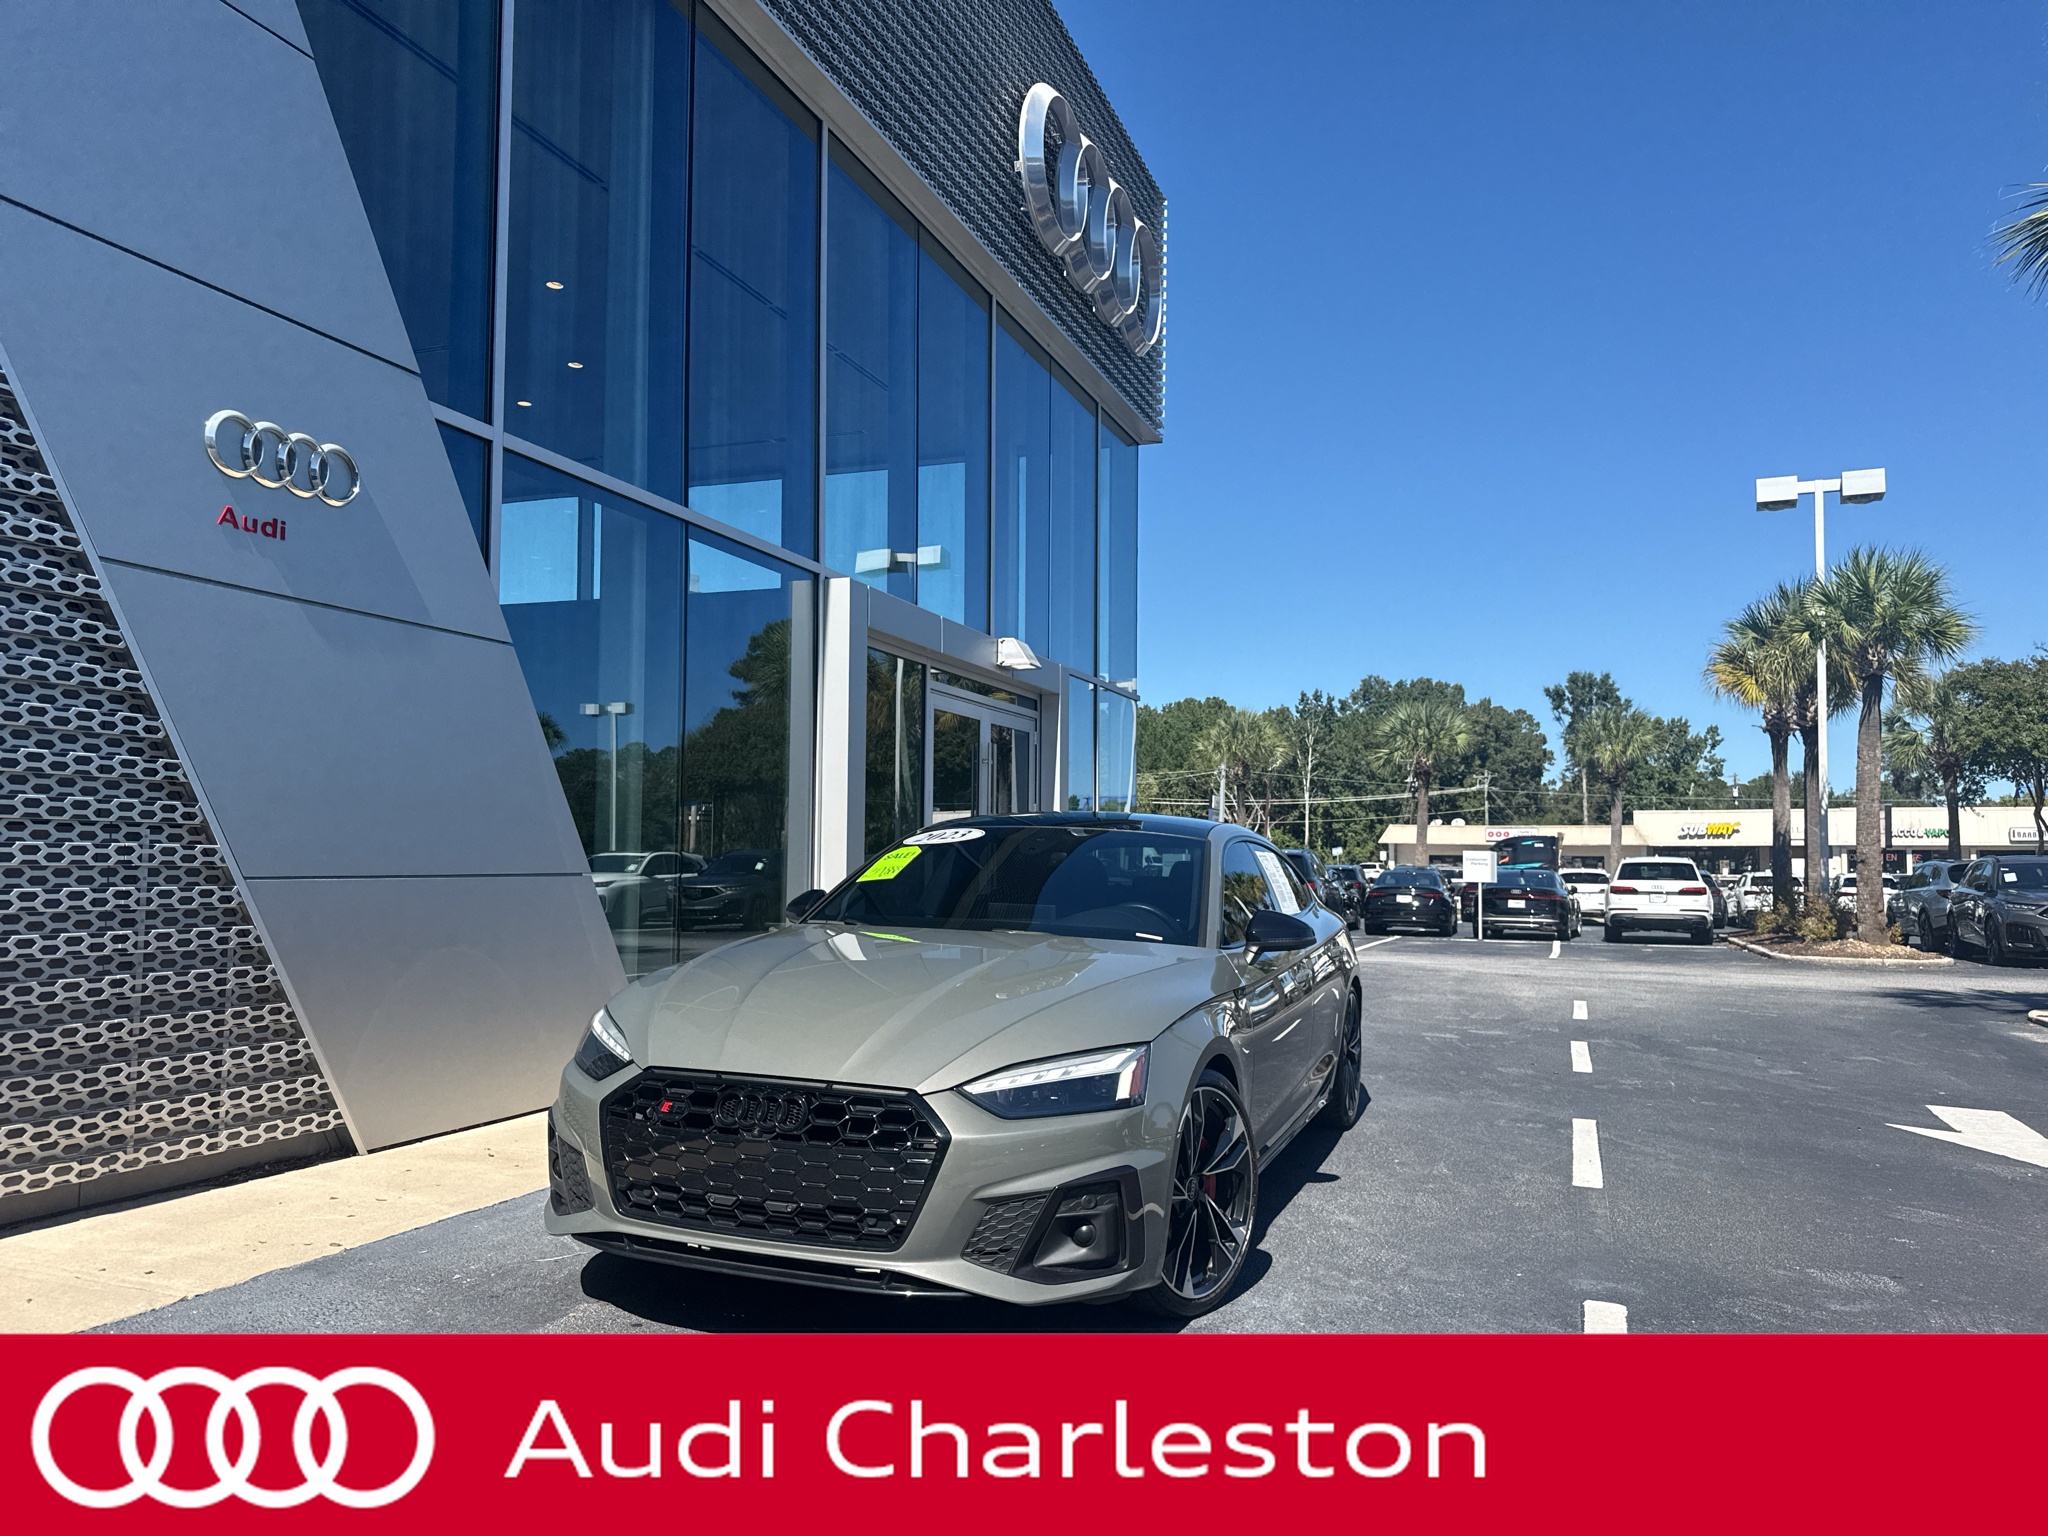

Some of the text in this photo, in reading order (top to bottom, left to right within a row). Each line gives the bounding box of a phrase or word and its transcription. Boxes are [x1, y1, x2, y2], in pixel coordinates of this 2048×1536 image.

[217, 504, 286, 541] Audi
[912, 830, 973, 842] 2023
[1679, 822, 1735, 837] SUBWAY
[884, 851, 916, 861] SALE!
